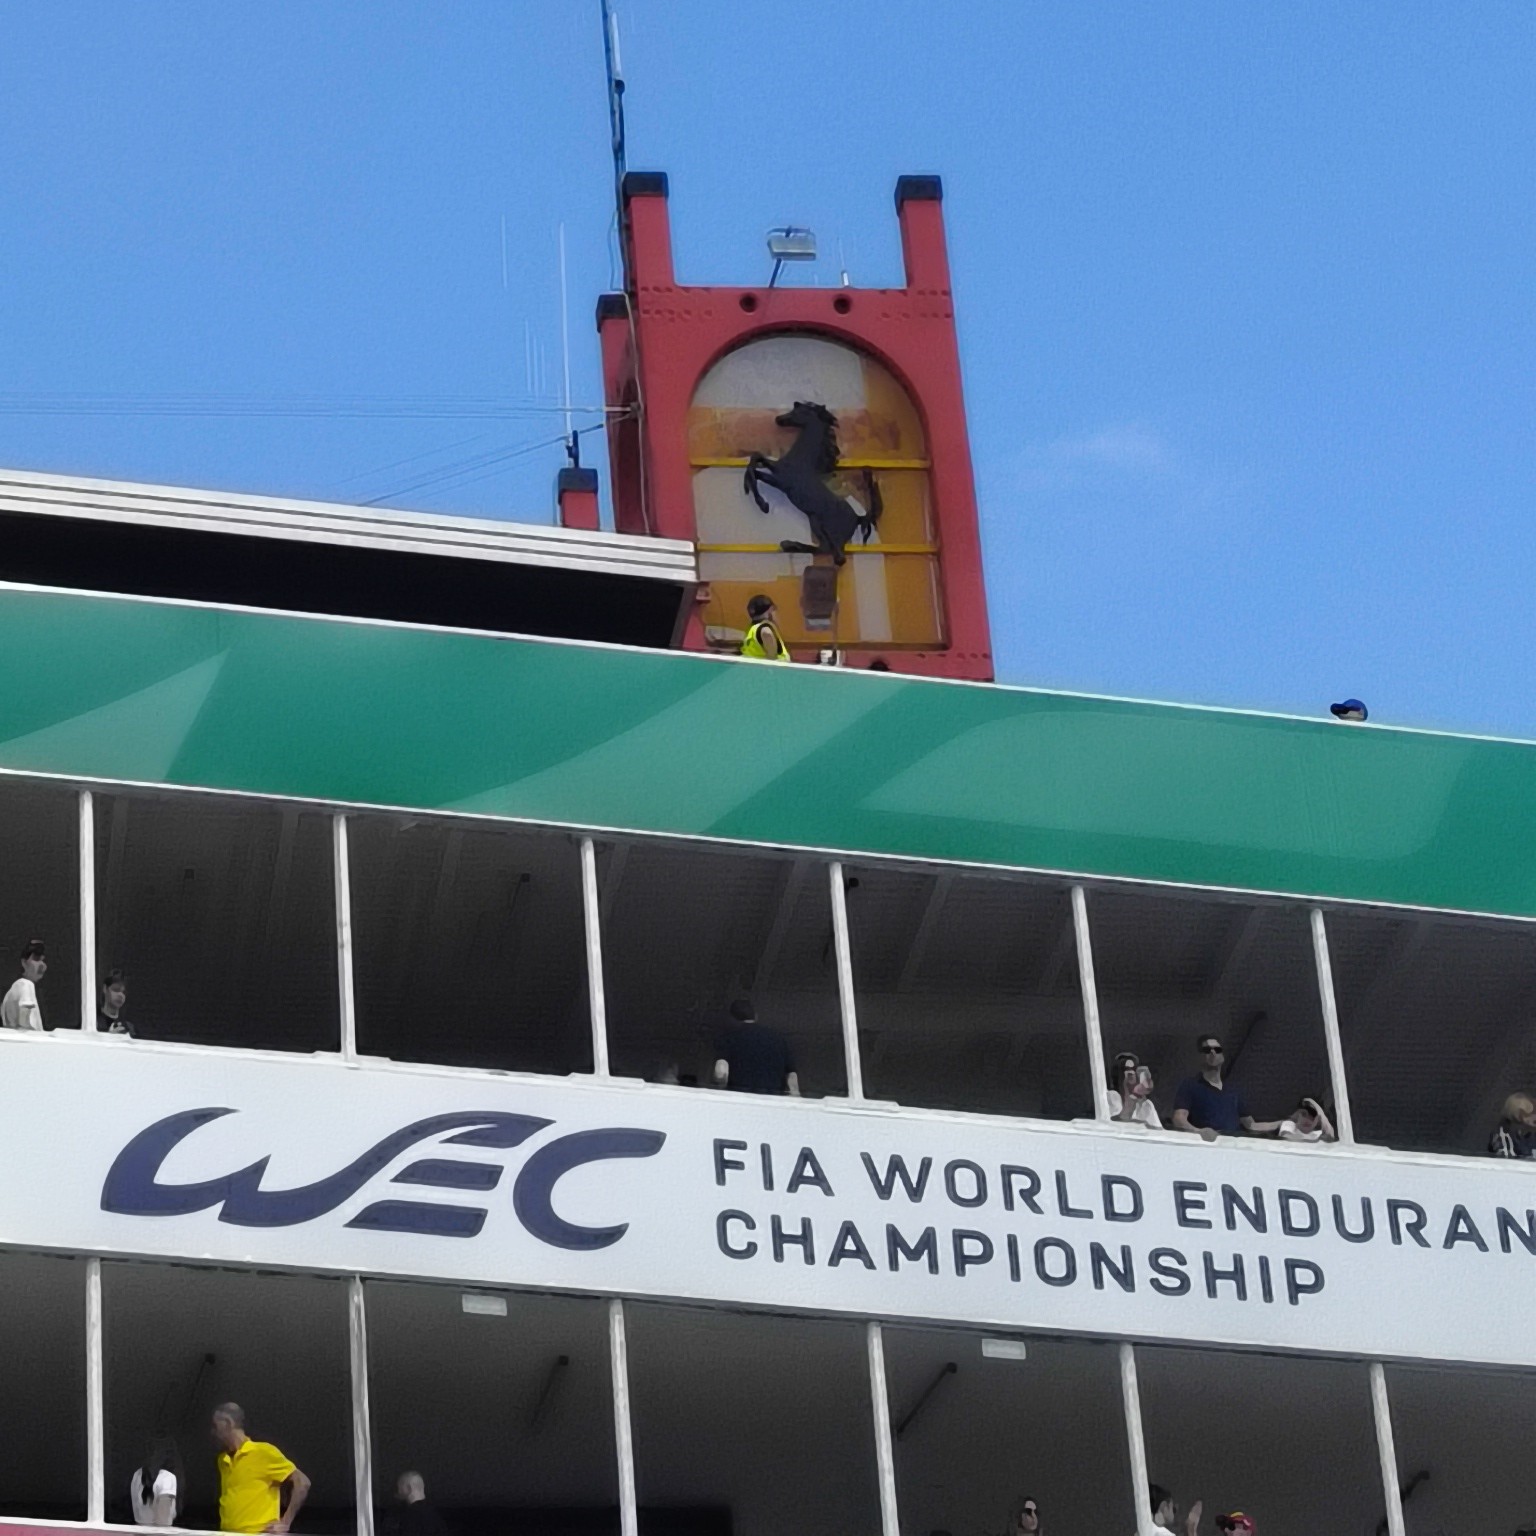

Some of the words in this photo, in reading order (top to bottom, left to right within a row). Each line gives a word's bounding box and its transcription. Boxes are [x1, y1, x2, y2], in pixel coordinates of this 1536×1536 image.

[99, 1106, 668, 1252] WEC
[712, 1138, 835, 1197] FIA
[859, 1151, 1146, 1224] WORLD
[1171, 1179, 1536, 1256] ENDURAN
[715, 1207, 1327, 1307] CHAMPIONSHIP
